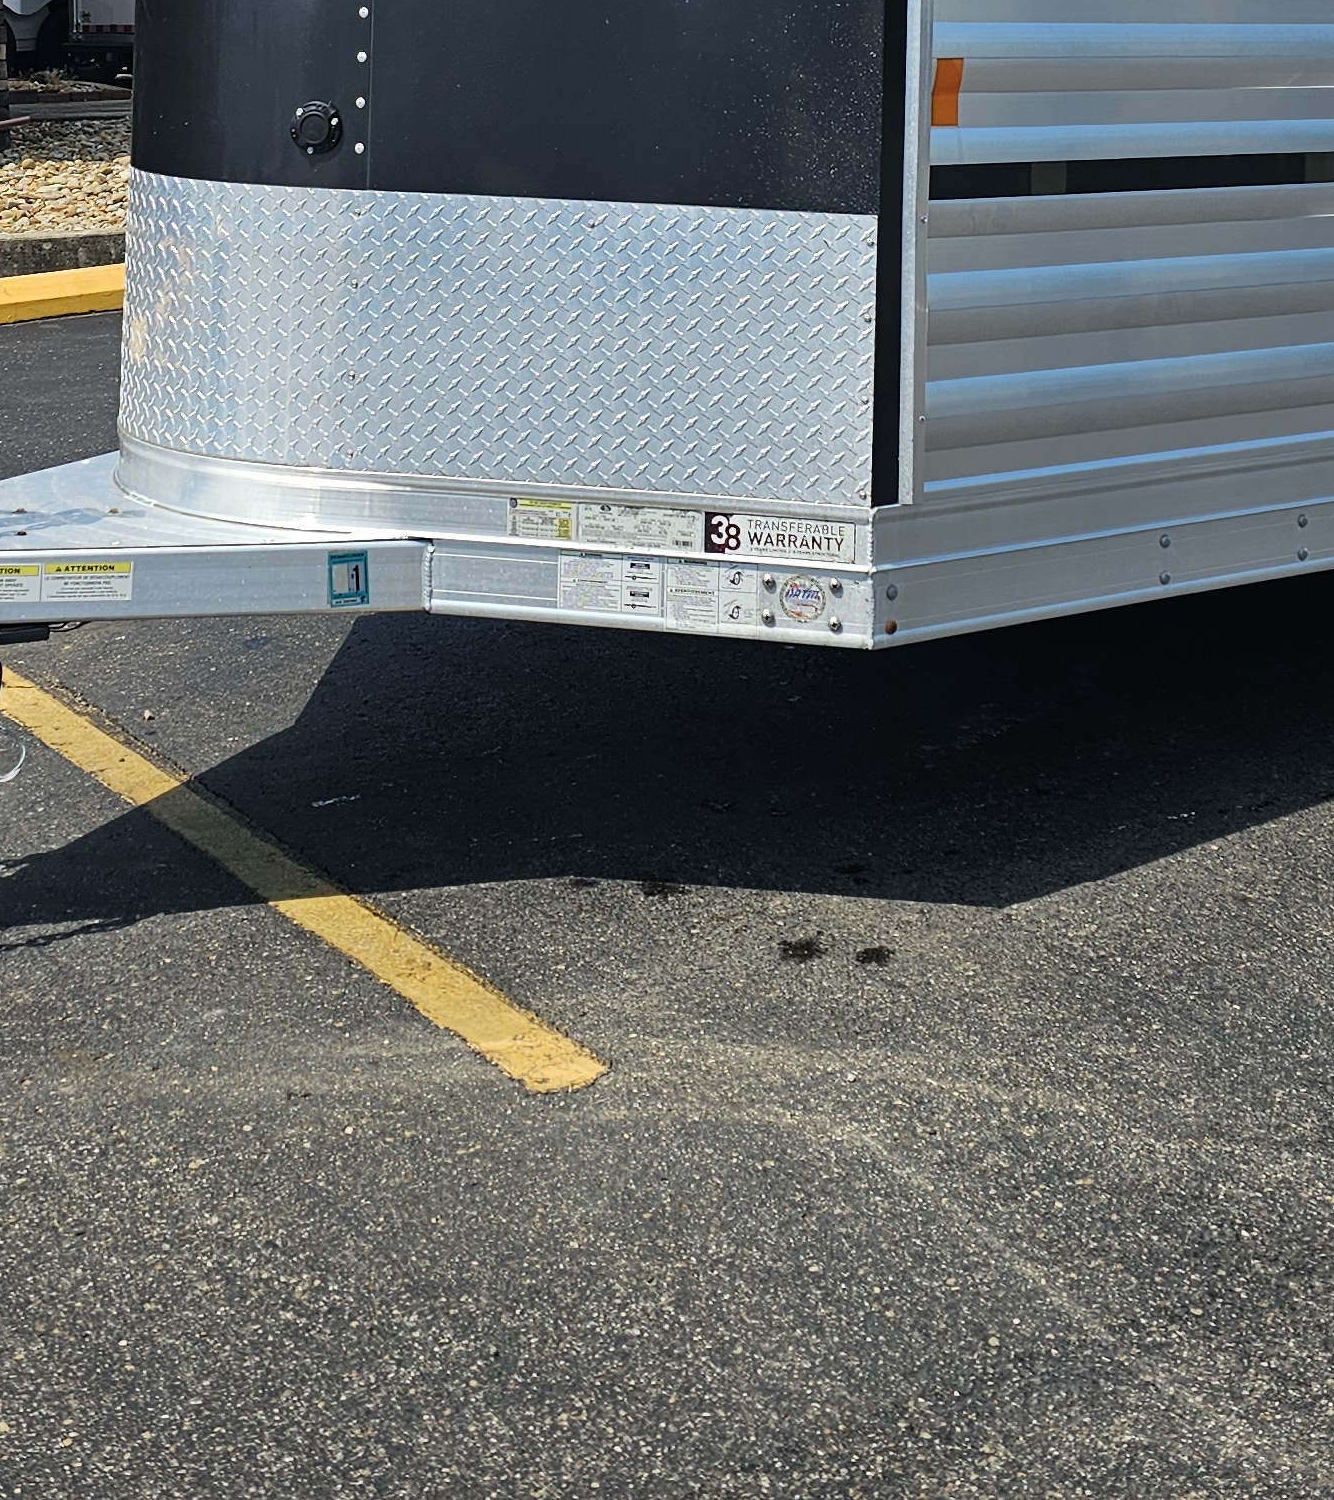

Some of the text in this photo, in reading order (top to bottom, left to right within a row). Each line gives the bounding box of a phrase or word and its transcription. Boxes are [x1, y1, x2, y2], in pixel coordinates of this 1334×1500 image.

[747, 519, 846, 537] TRANSFERABLE
[747, 531, 845, 552] WARRANTY
[64, 564, 115, 572] ATTENTION
